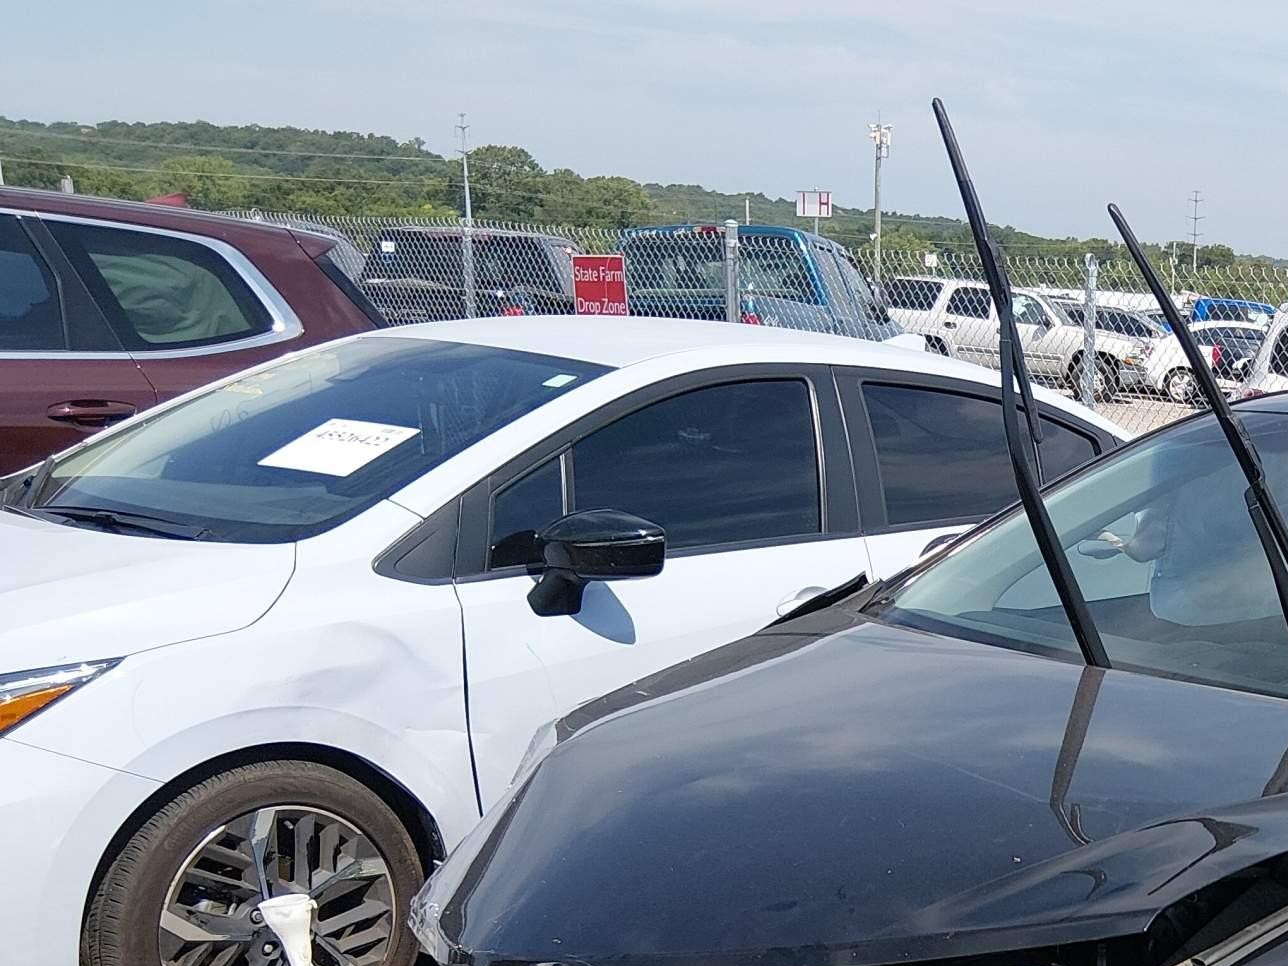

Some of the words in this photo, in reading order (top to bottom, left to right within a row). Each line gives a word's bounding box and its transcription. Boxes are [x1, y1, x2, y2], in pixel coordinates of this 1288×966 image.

[575, 266, 598, 282] State
[599, 266, 624, 282] Farm
[578, 297, 600, 315] Drop
[601, 298, 626, 314] Zone
